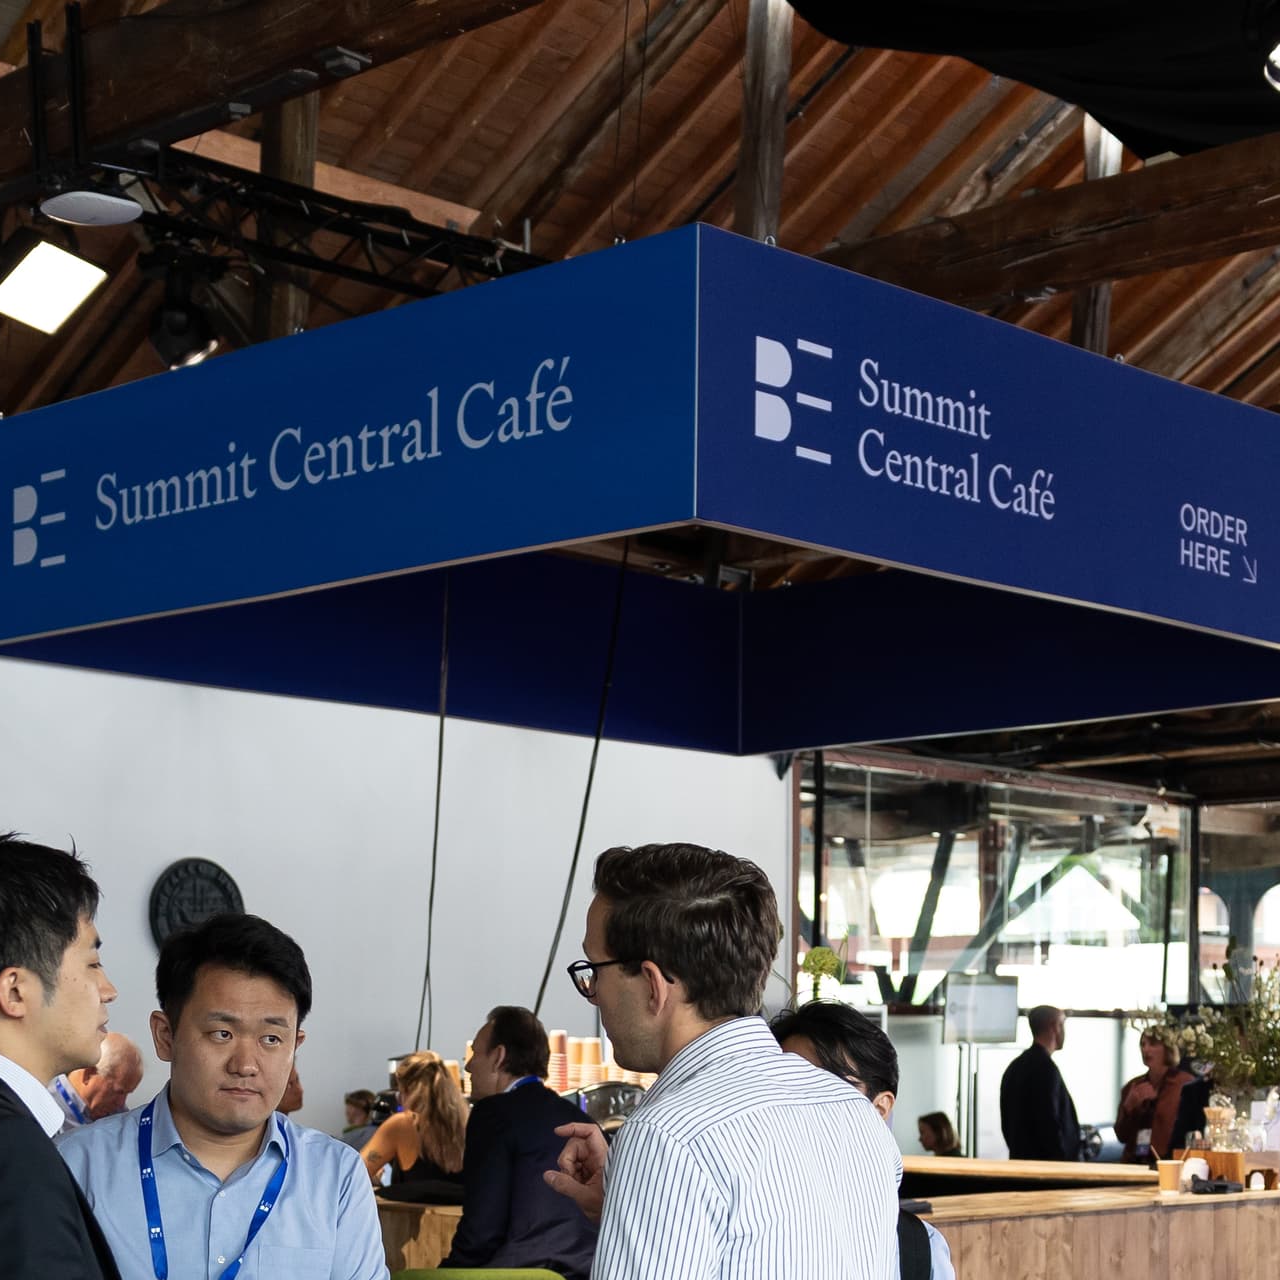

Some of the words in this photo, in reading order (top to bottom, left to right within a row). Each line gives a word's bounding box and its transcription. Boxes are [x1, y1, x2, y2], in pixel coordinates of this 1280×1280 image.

[858, 358, 991, 440] Summit
[95, 441, 257, 531] Summit
[269, 386, 442, 491] Central
[456, 356, 573, 449] Café
[858, 428, 981, 502] Central
[989, 463, 1056, 521] Café
[1180, 503, 1248, 547] ORDER
[1180, 537, 1231, 577] HERE
